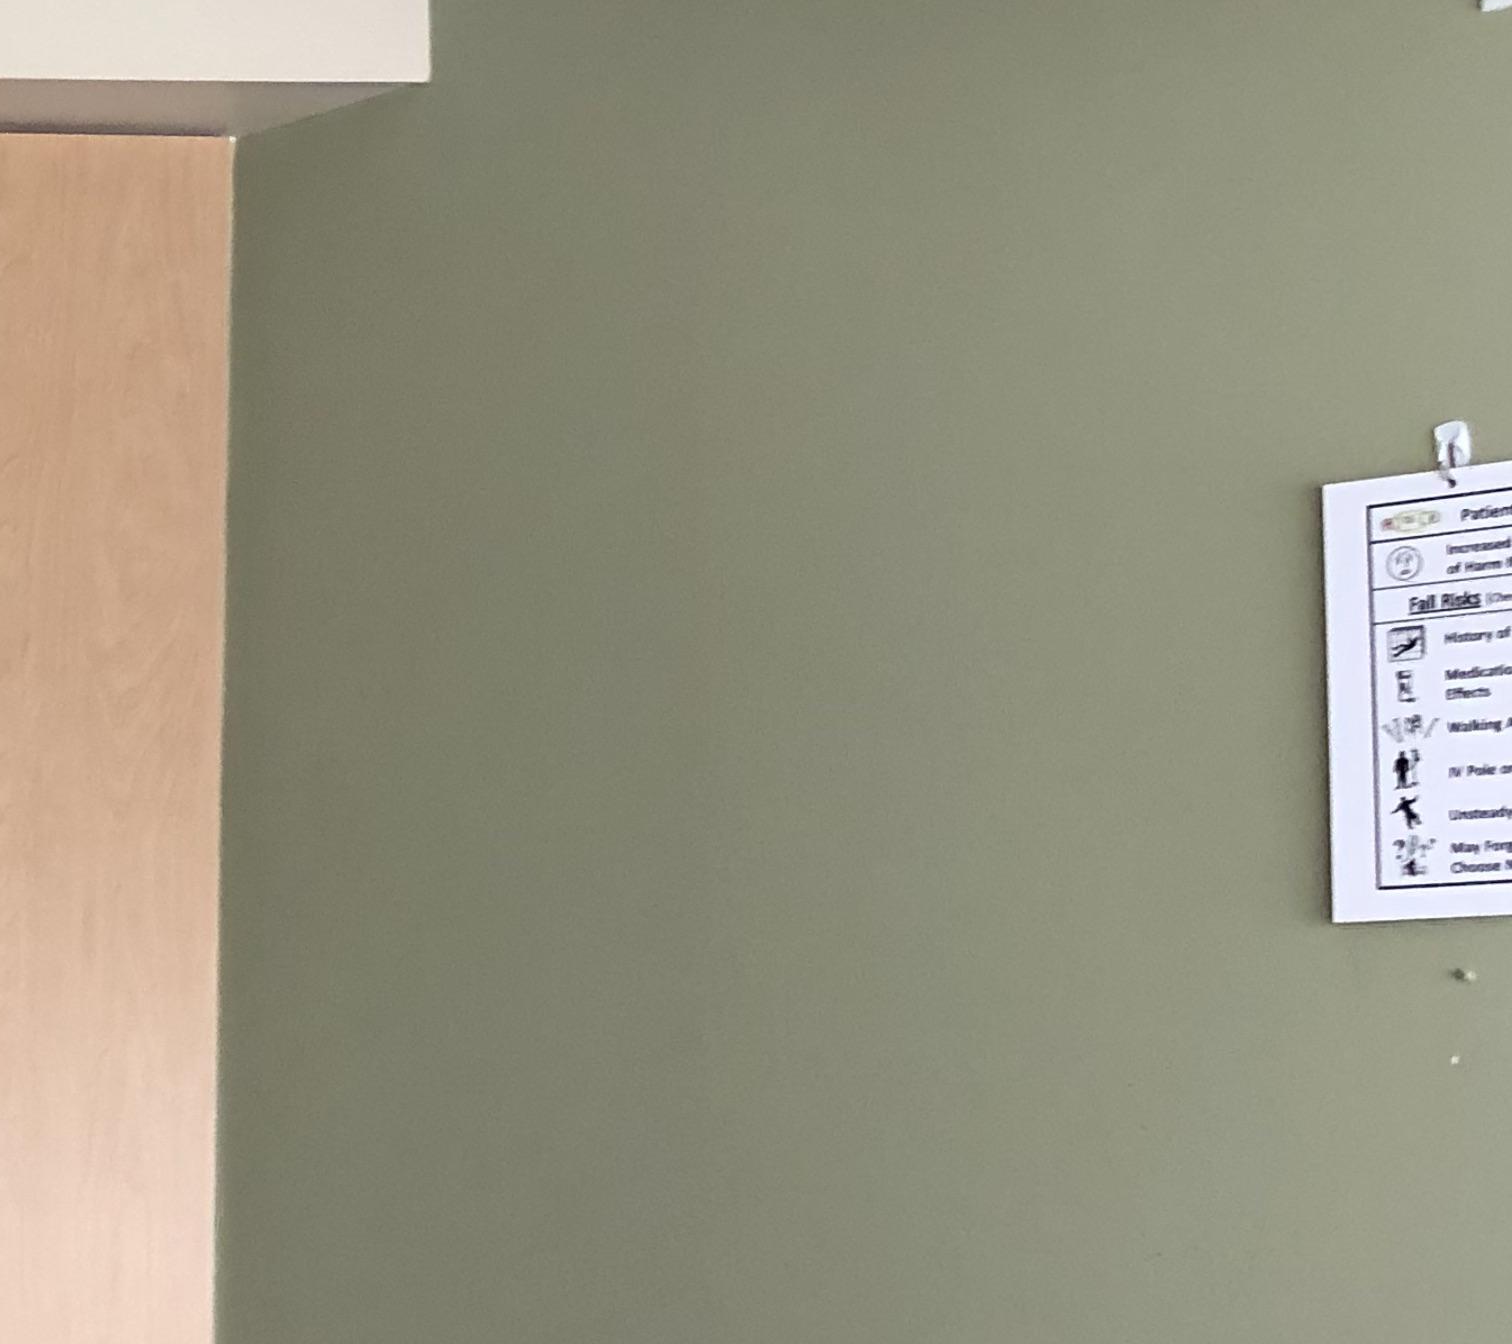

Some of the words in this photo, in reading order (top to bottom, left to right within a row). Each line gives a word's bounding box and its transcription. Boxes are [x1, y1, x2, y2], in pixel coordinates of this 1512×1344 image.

[1446, 536, 1511, 555] Increased
[1446, 562, 1462, 575] of
[1464, 560, 1503, 573] Harm
[1409, 594, 1436, 612] Fall
[1441, 591, 1482, 609] Risks
[1444, 631, 1493, 644] History
[1496, 625, 1511, 639] of
[1445, 687, 1492, 700] Effects
[1447, 719, 1502, 733] Walking
[1466, 763, 1497, 777] Pole
[1450, 842, 1480, 855] May
[1450, 860, 1502, 874] Choose
